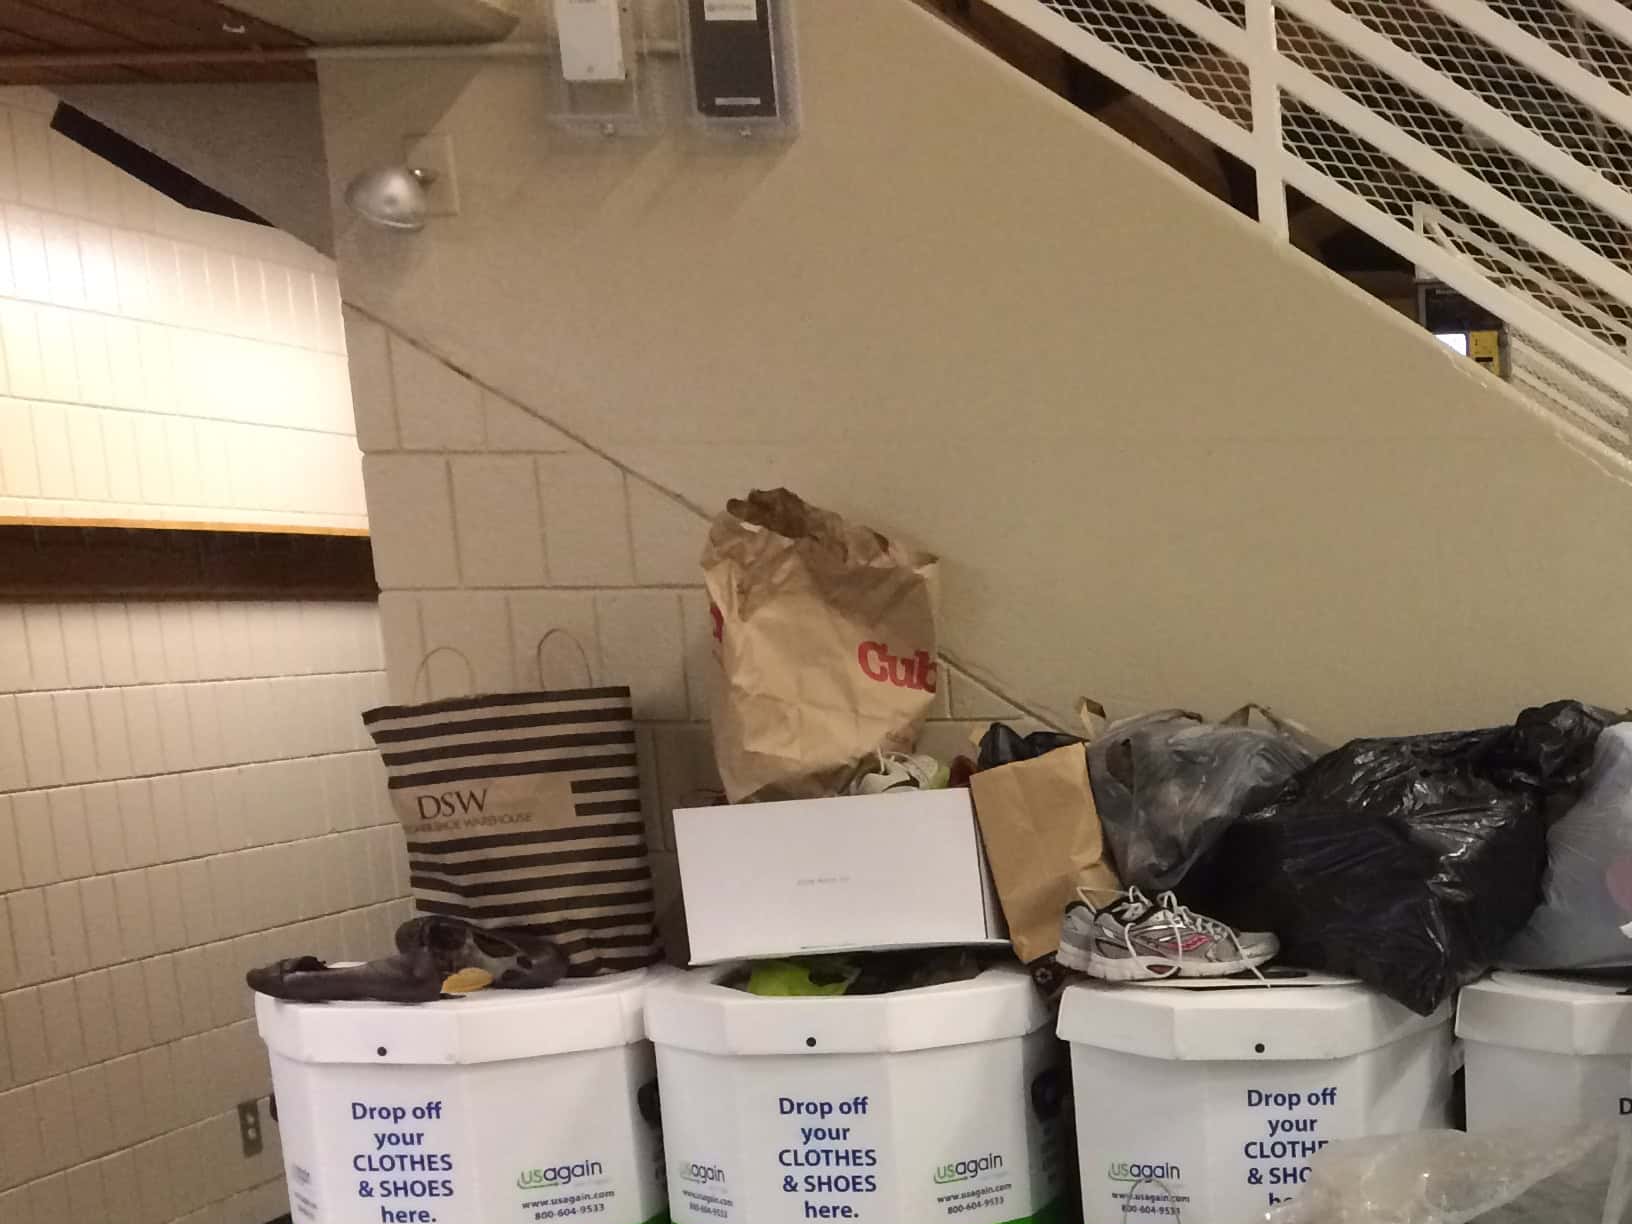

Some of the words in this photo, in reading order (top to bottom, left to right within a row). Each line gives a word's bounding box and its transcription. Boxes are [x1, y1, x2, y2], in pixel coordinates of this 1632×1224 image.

[858, 641, 937, 693] Cub
[416, 788, 488, 820] DSW
[779, 1097, 833, 1119] Drop
[838, 1096, 868, 1115] off
[1248, 1089, 1300, 1110] Drop
[1307, 1087, 1336, 1106] off
[352, 1102, 406, 1123] Drop
[412, 1101, 442, 1120] off
[801, 1126, 850, 1145] your
[1268, 1118, 1317, 1137] your
[374, 1130, 424, 1149] your
[353, 1154, 453, 1172] CLOTHES
[778, 1149, 877, 1167] CLOTHES
[935, 1153, 1004, 1181] usagain
[519, 1160, 603, 1186] usagain
[1109, 1162, 1180, 1182] usagain
[1248, 1168, 1263, 1185] &
[1269, 1168, 1312, 1185] SHO
[358, 1180, 374, 1197] &
[380, 1179, 454, 1198] SHOES
[782, 1176, 799, 1193] &
[804, 1175, 877, 1193] SHOES
[937, 1182, 1012, 1204] www.usagain.com
[521, 1190, 615, 1209] www.usagain.com
[381, 1205, 437, 1224] here.
[535, 1203, 605, 1220] 800-604-9533
[805, 1201, 859, 1219] here.
